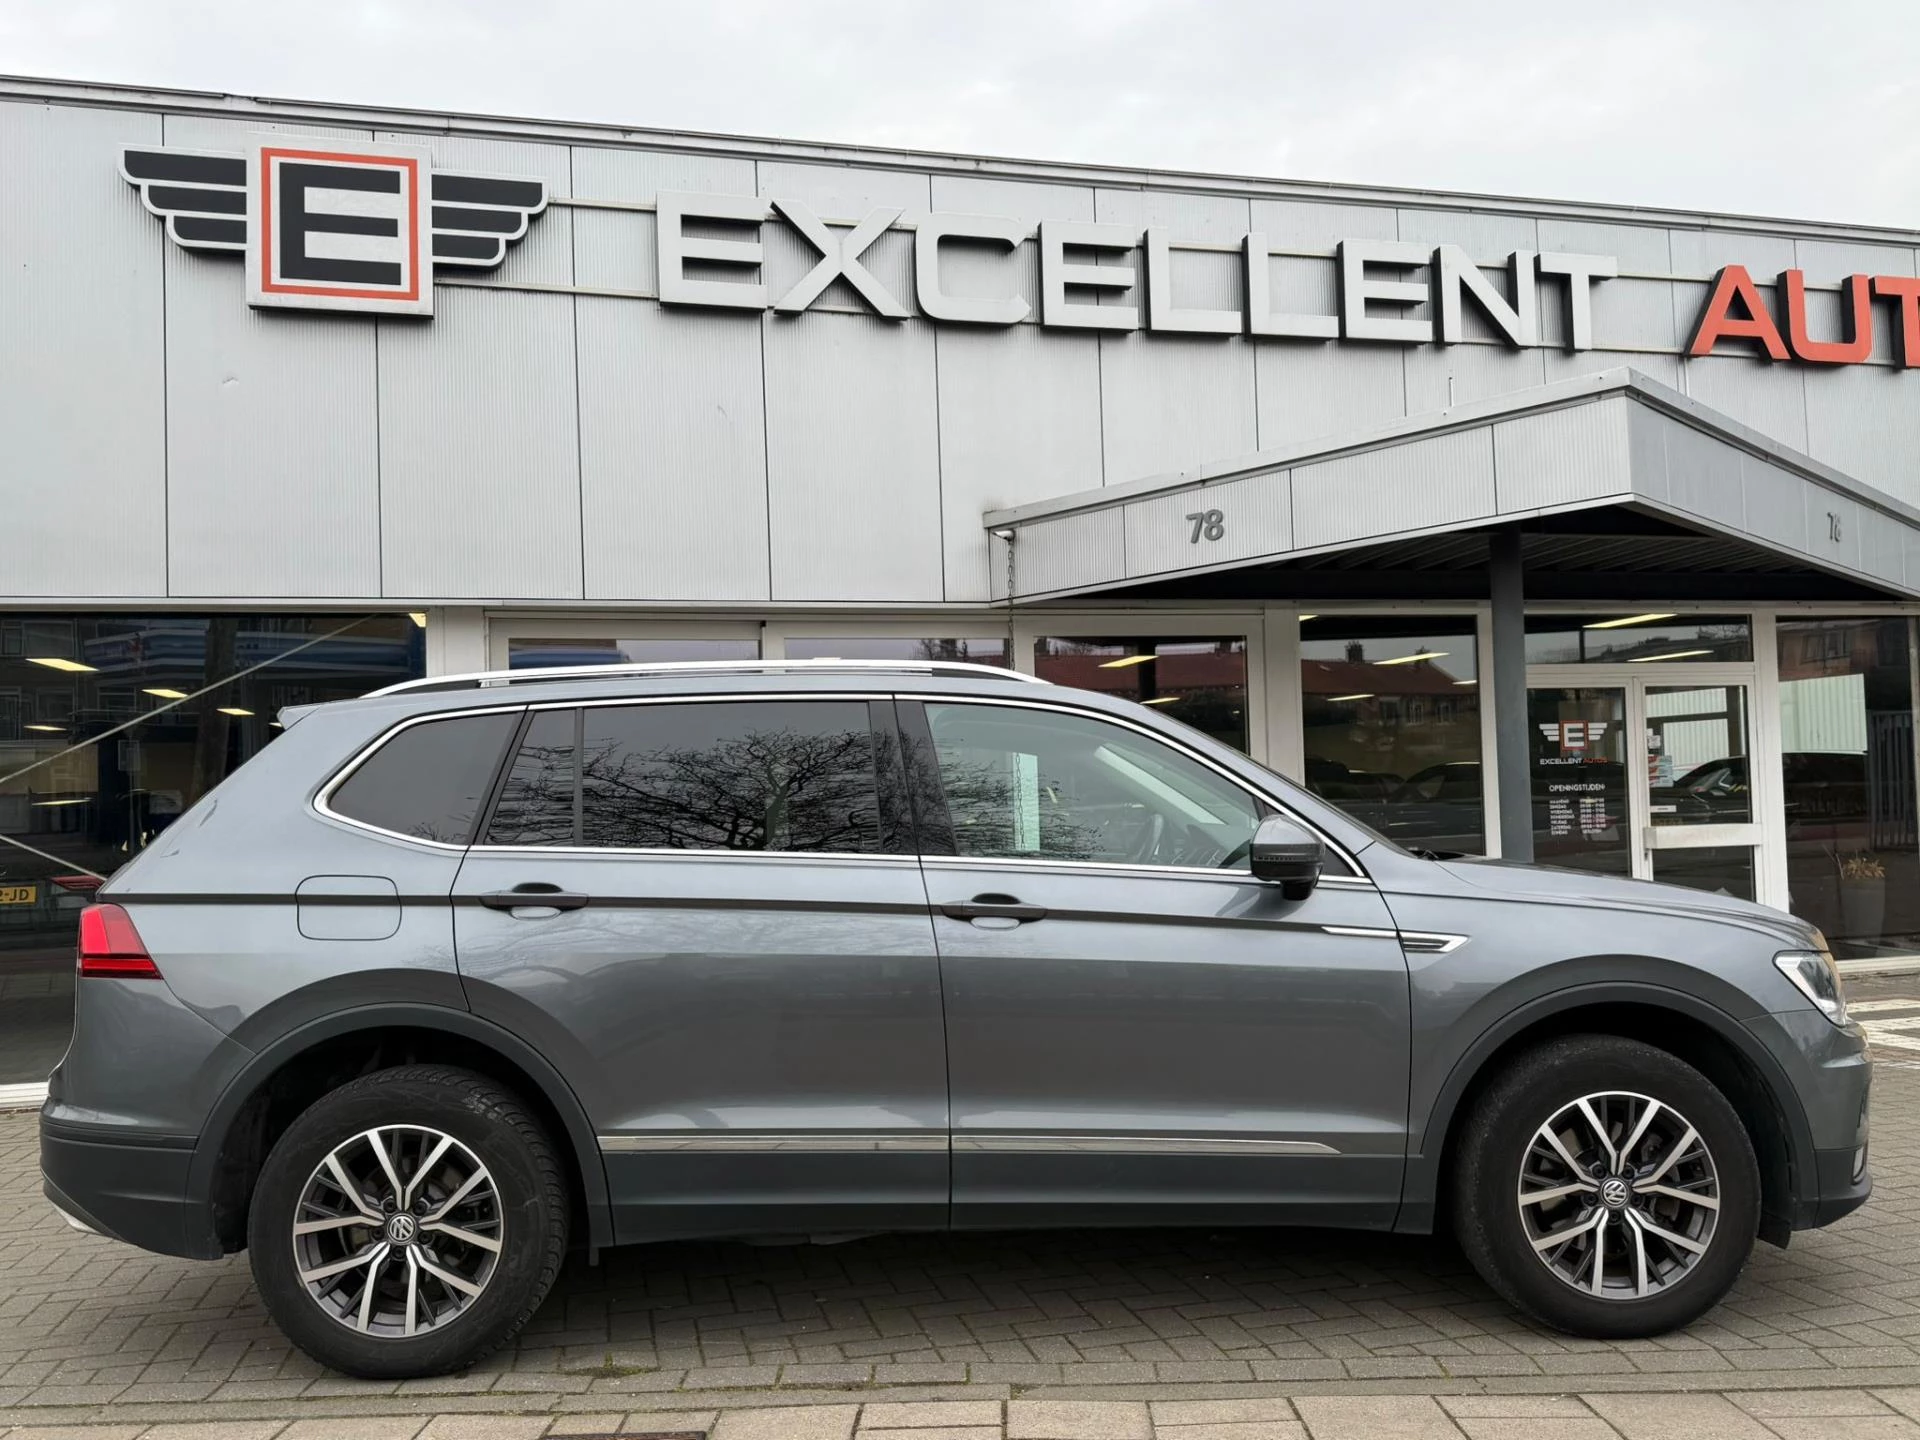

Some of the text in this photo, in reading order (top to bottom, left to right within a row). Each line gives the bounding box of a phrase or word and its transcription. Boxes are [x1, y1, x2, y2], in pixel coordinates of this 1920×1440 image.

[656, 190, 1920, 368] EXCELLENT AUT
[1186, 509, 1224, 544] 78
[1539, 757, 1582, 765] EXCELLENT
